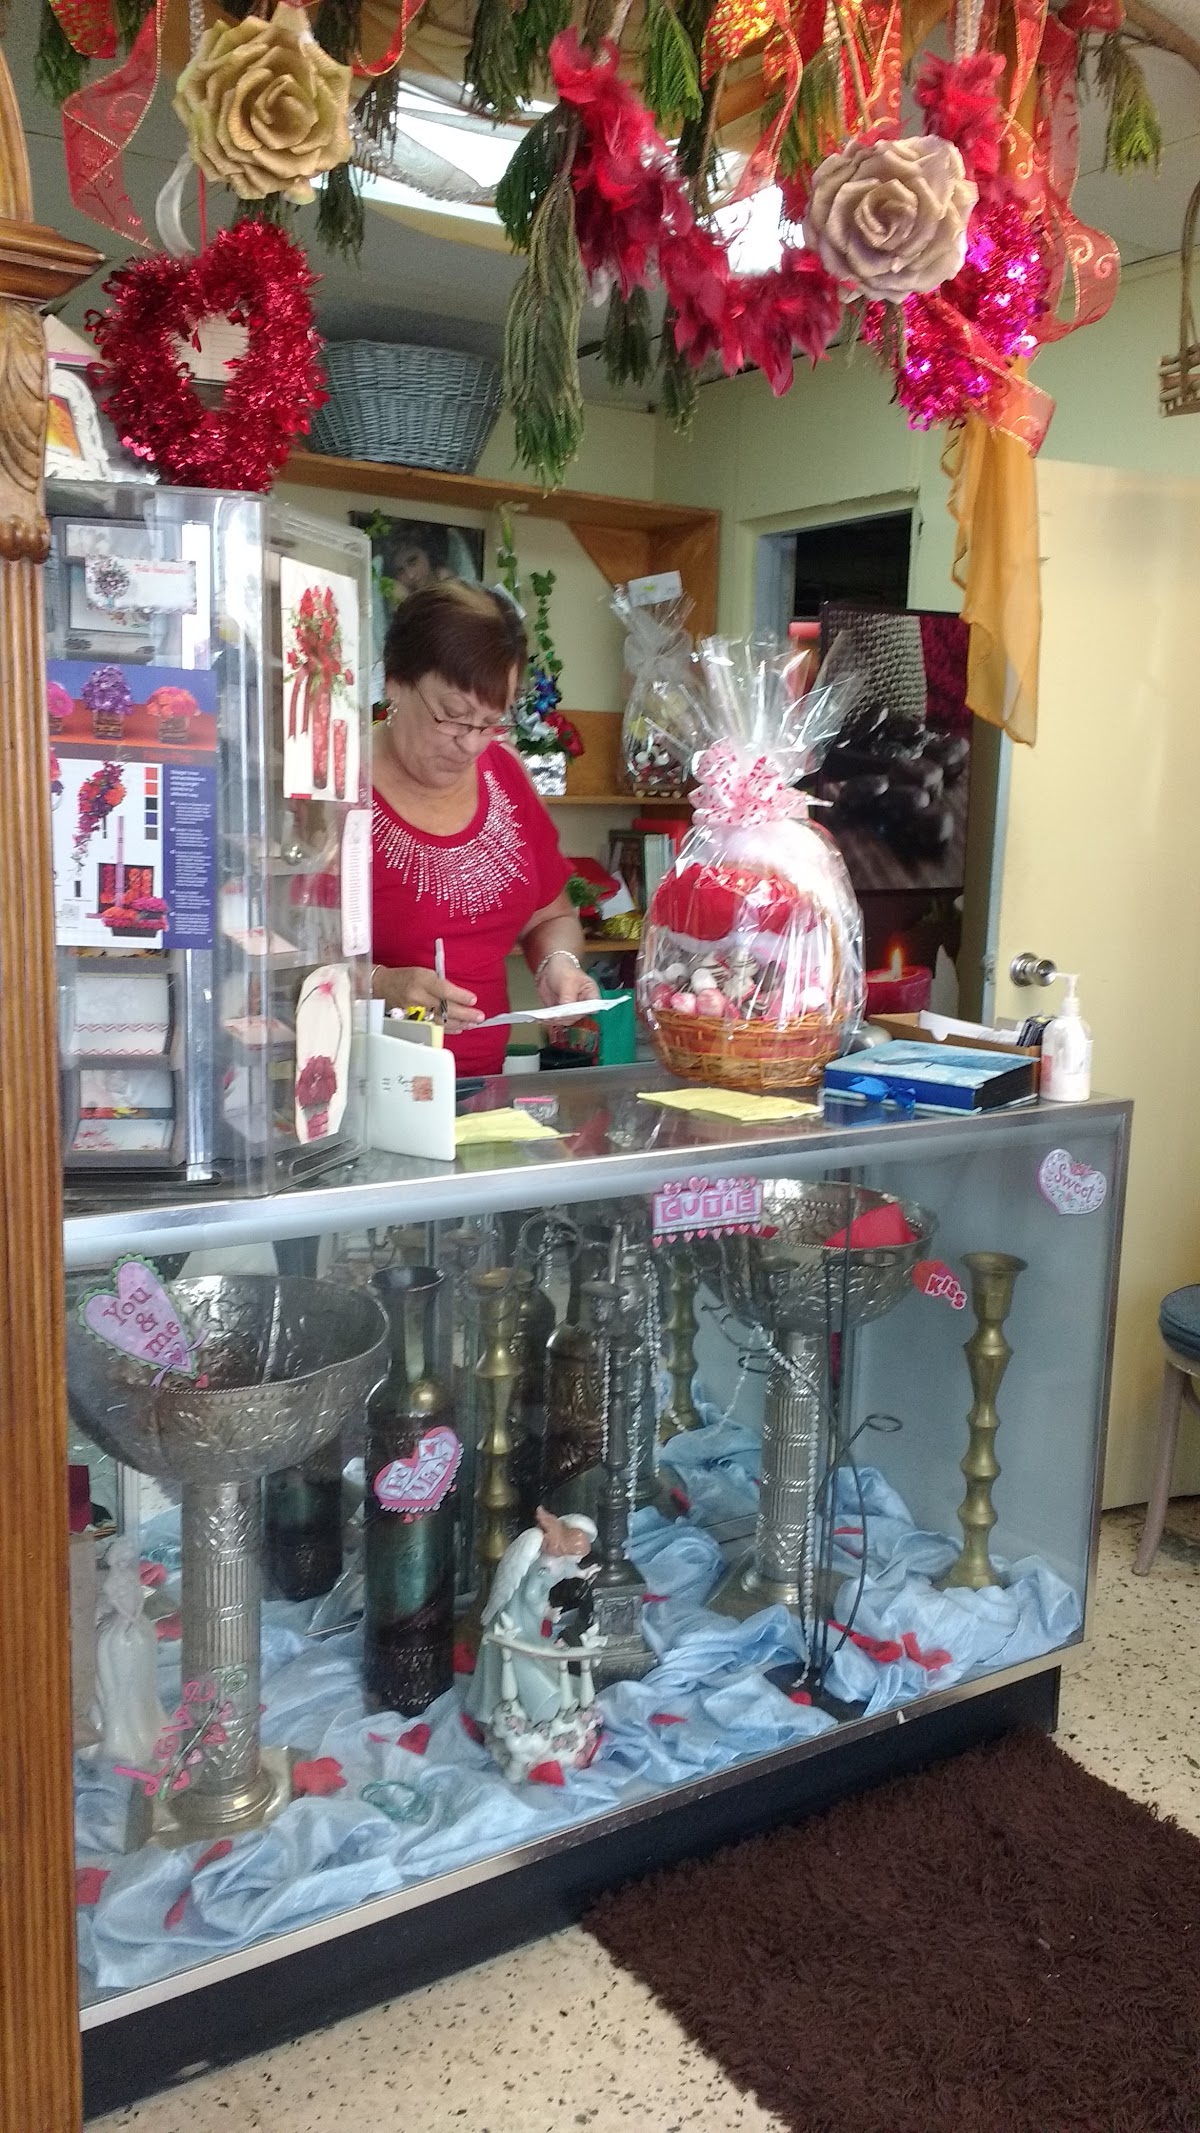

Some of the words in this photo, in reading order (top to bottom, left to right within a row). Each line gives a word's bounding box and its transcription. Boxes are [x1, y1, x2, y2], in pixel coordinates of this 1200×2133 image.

[1055, 1163, 1095, 1204] Sweet
[102, 1287, 153, 1327] You
[135, 1312, 159, 1333] &
[143, 1321, 180, 1358] me
